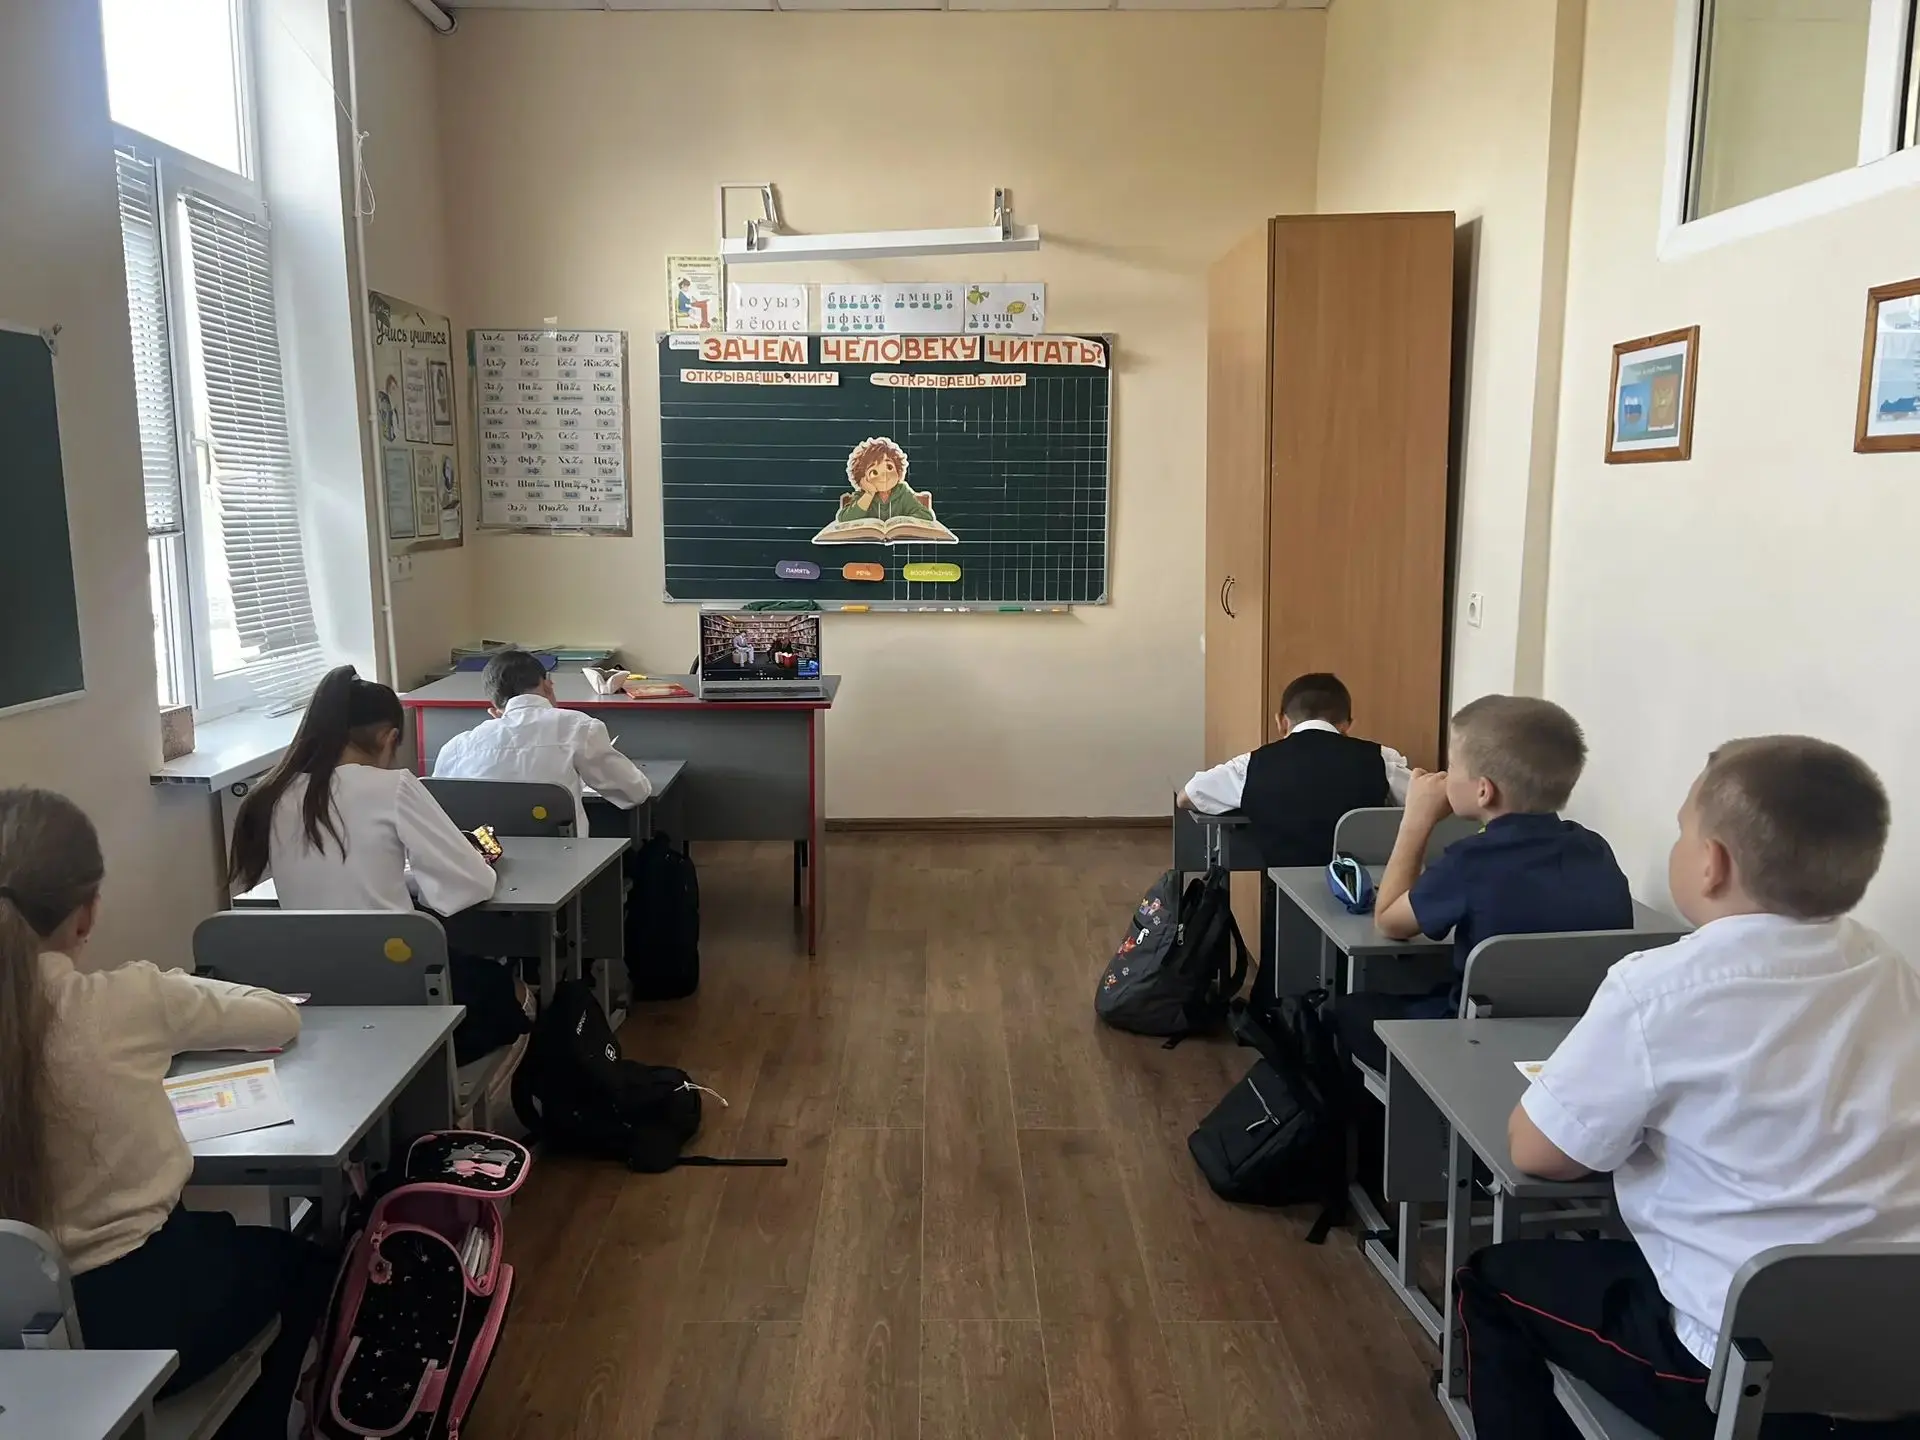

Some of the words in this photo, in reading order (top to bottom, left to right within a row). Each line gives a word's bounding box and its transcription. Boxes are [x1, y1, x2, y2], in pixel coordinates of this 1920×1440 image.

[376, 319, 407, 345] Учись
[410, 330, 447, 349] учиться
[703, 337, 804, 362] ЗАЧЕМ
[823, 335, 978, 362] ЧЕЛОВЕКУ
[987, 339, 1105, 364] ЧИТАТЬ?
[685, 370, 784, 383] ОТКРЫВАЕШЬ
[789, 371, 833, 384] КНИГУ
[889, 374, 986, 386] ОТКРЫВАЕШЬ
[991, 374, 1022, 386] МИР
[785, 567, 810, 575] ПАМЯТЬ
